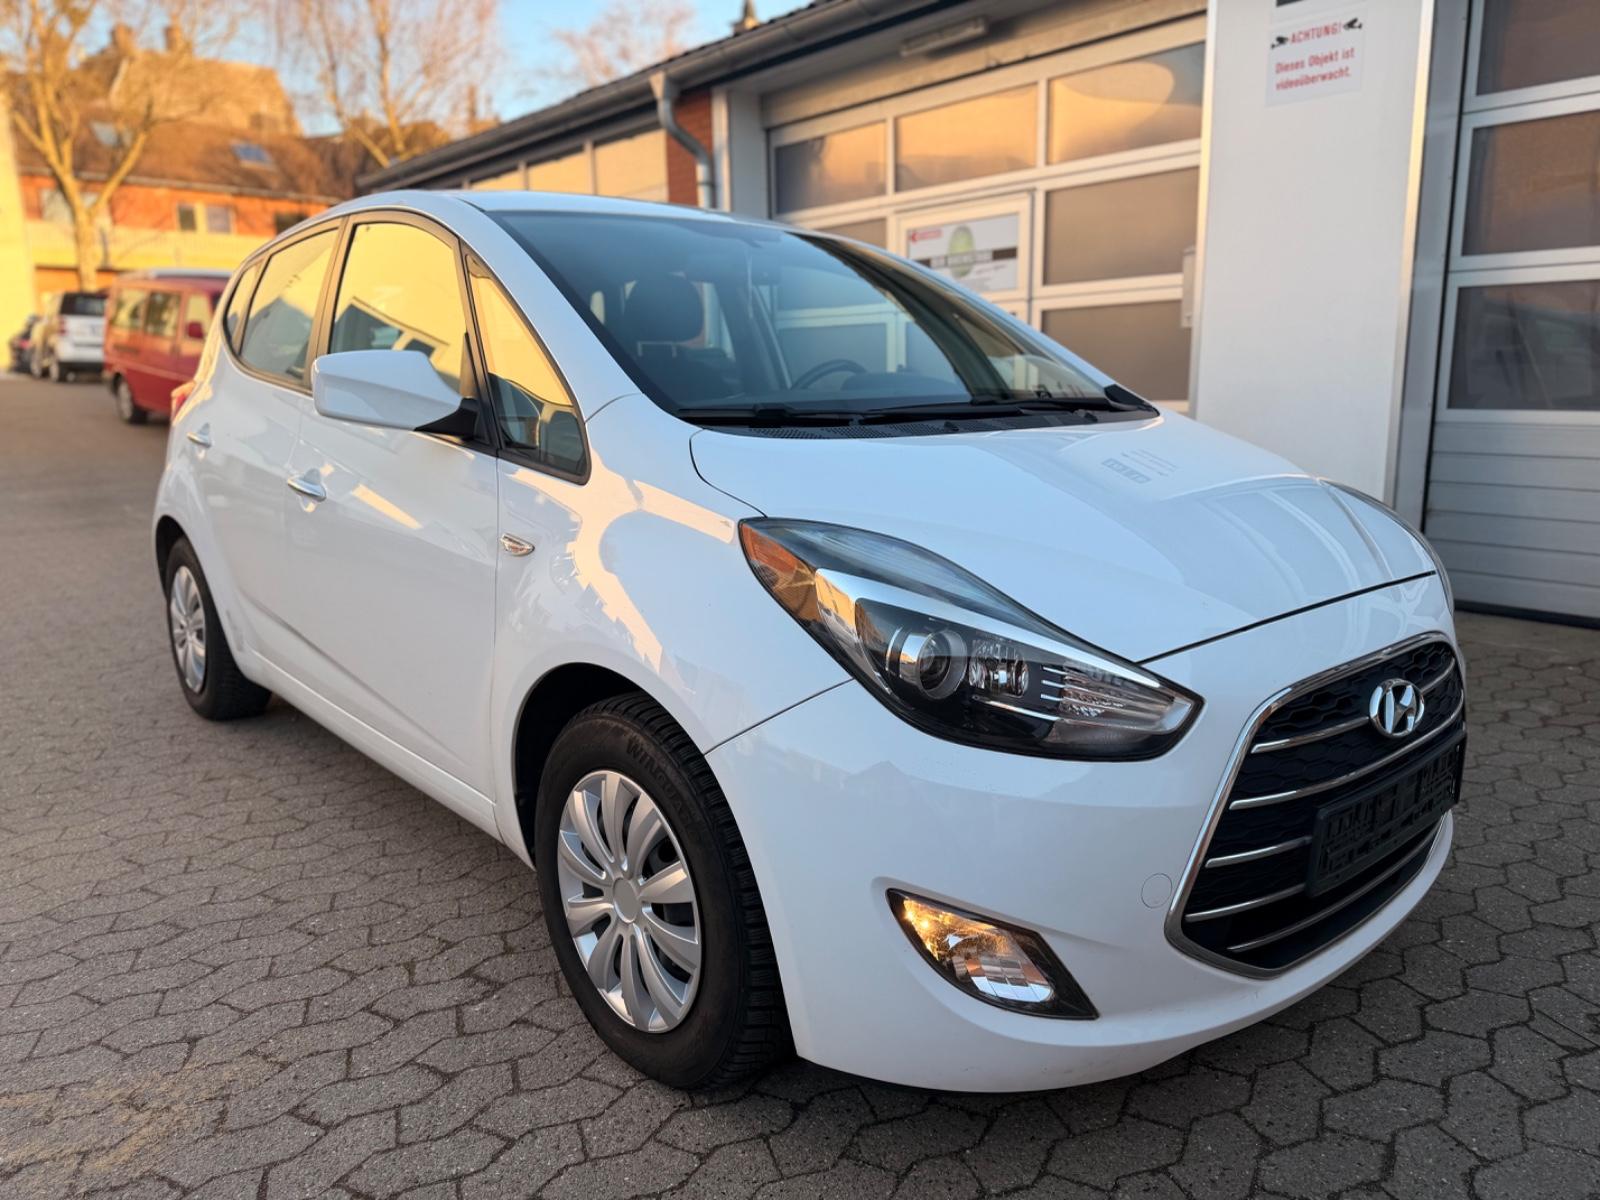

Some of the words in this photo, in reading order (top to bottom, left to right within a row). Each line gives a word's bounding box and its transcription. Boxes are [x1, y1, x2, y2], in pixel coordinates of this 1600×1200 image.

[1291, 22, 1342, 44] ACHTUNG!
[1275, 60, 1305, 74] Dieses
[1308, 50, 1339, 67] Objekt
[1341, 47, 1355, 60] ist
